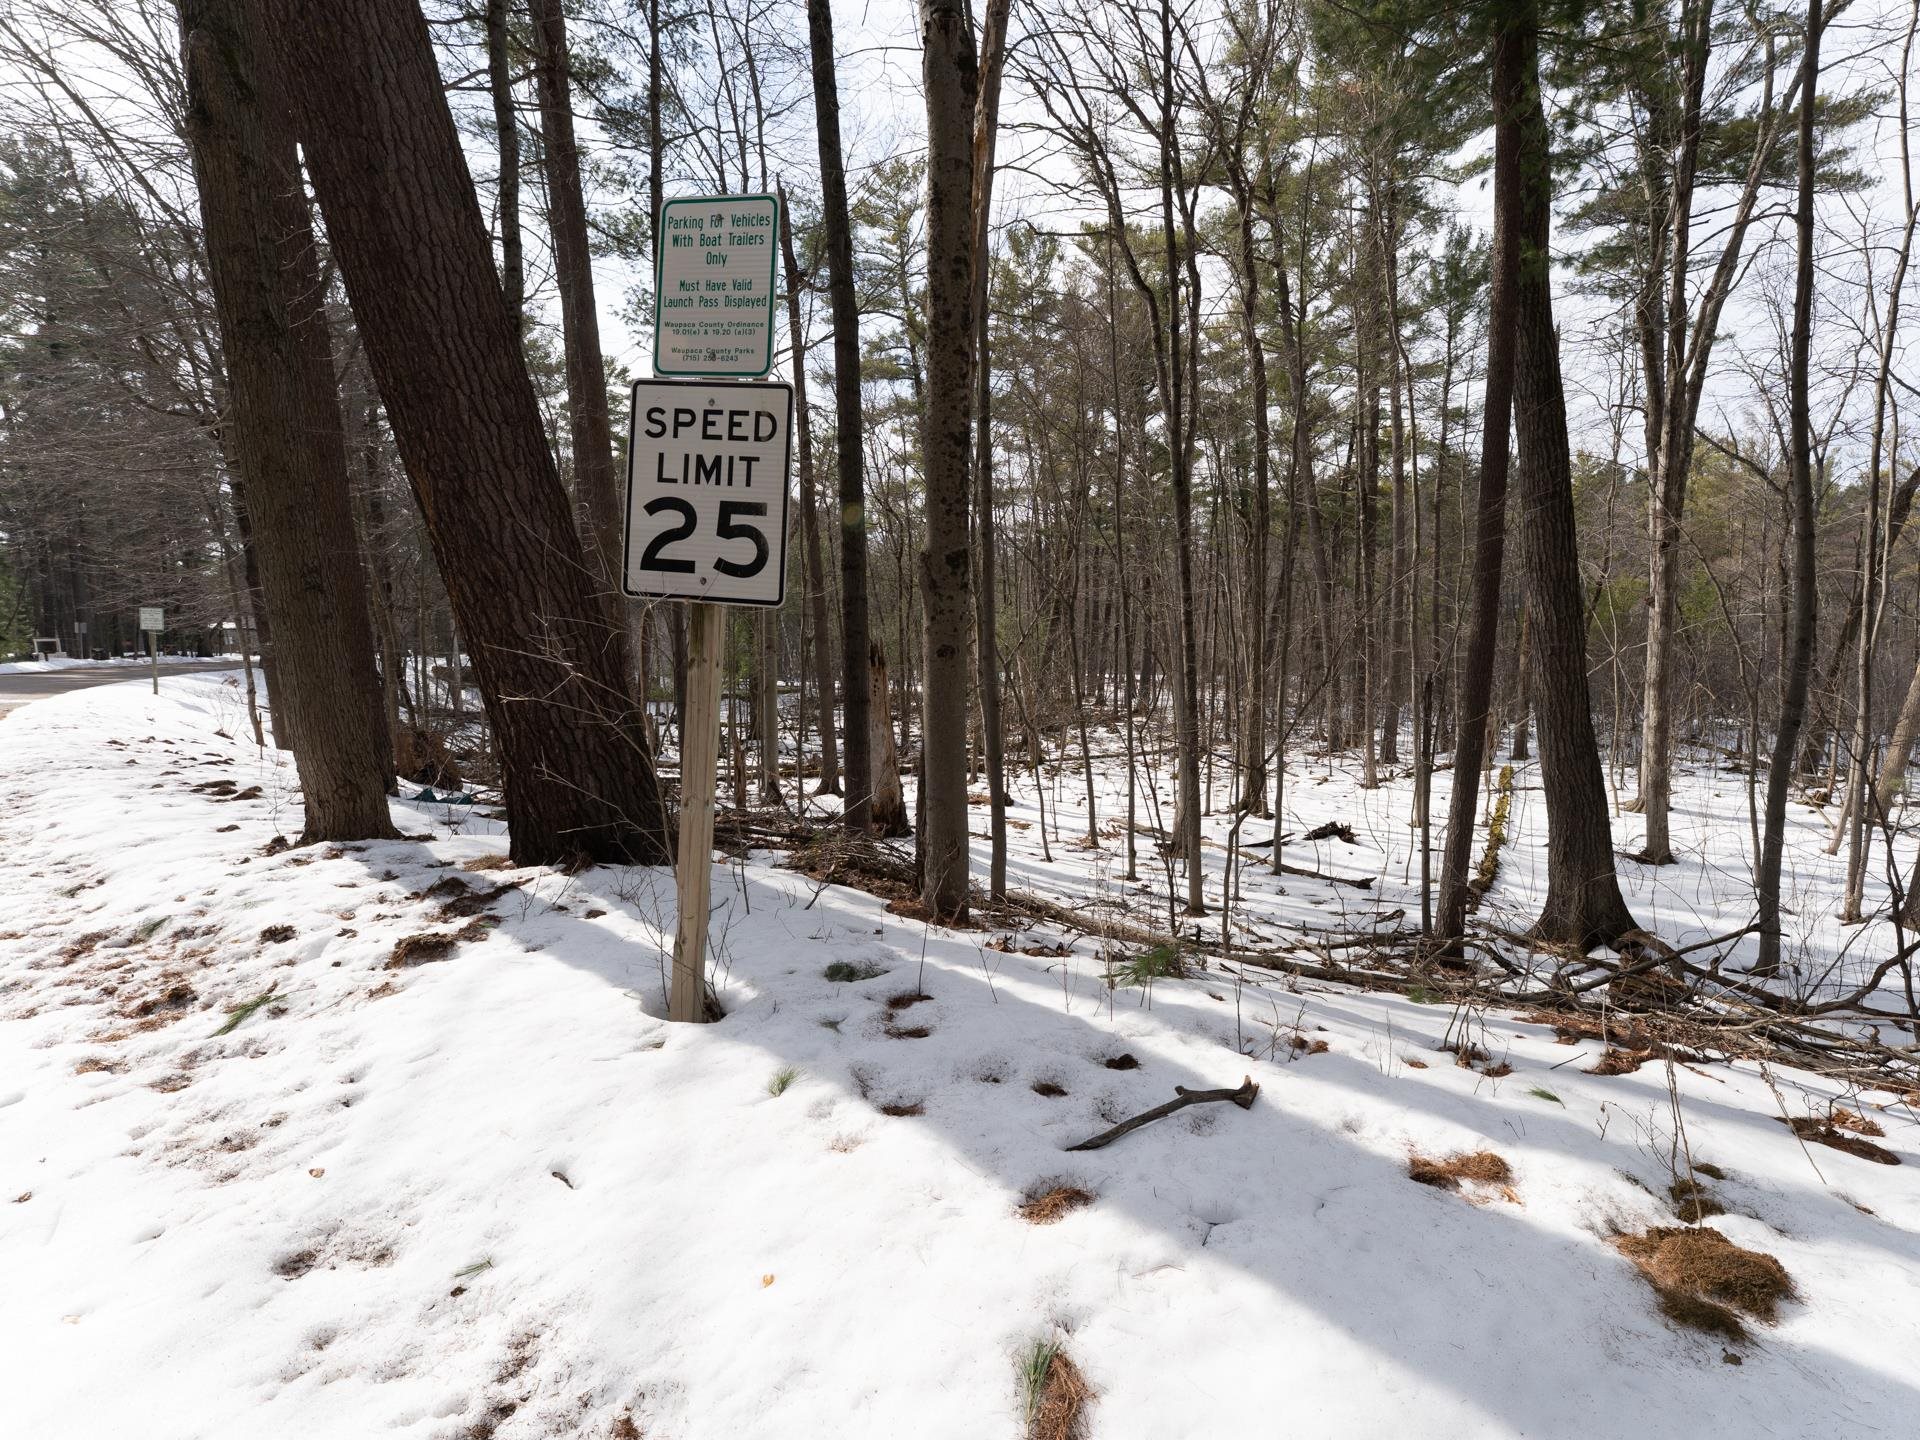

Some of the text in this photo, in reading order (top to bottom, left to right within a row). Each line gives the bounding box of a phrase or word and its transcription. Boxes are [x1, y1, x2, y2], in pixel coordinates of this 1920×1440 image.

[668, 213, 770, 231] Parking For Vehicles
[672, 232, 764, 247] With Boat Trailers
[706, 251, 727, 267] Only
[679, 279, 752, 291] Must Have Valid
[664, 295, 767, 308] Launch Pass Displayed
[706, 347, 731, 355] County
[644, 407, 777, 442] SPEED
[657, 452, 760, 487] LIMIT
[640, 496, 770, 578] 25
